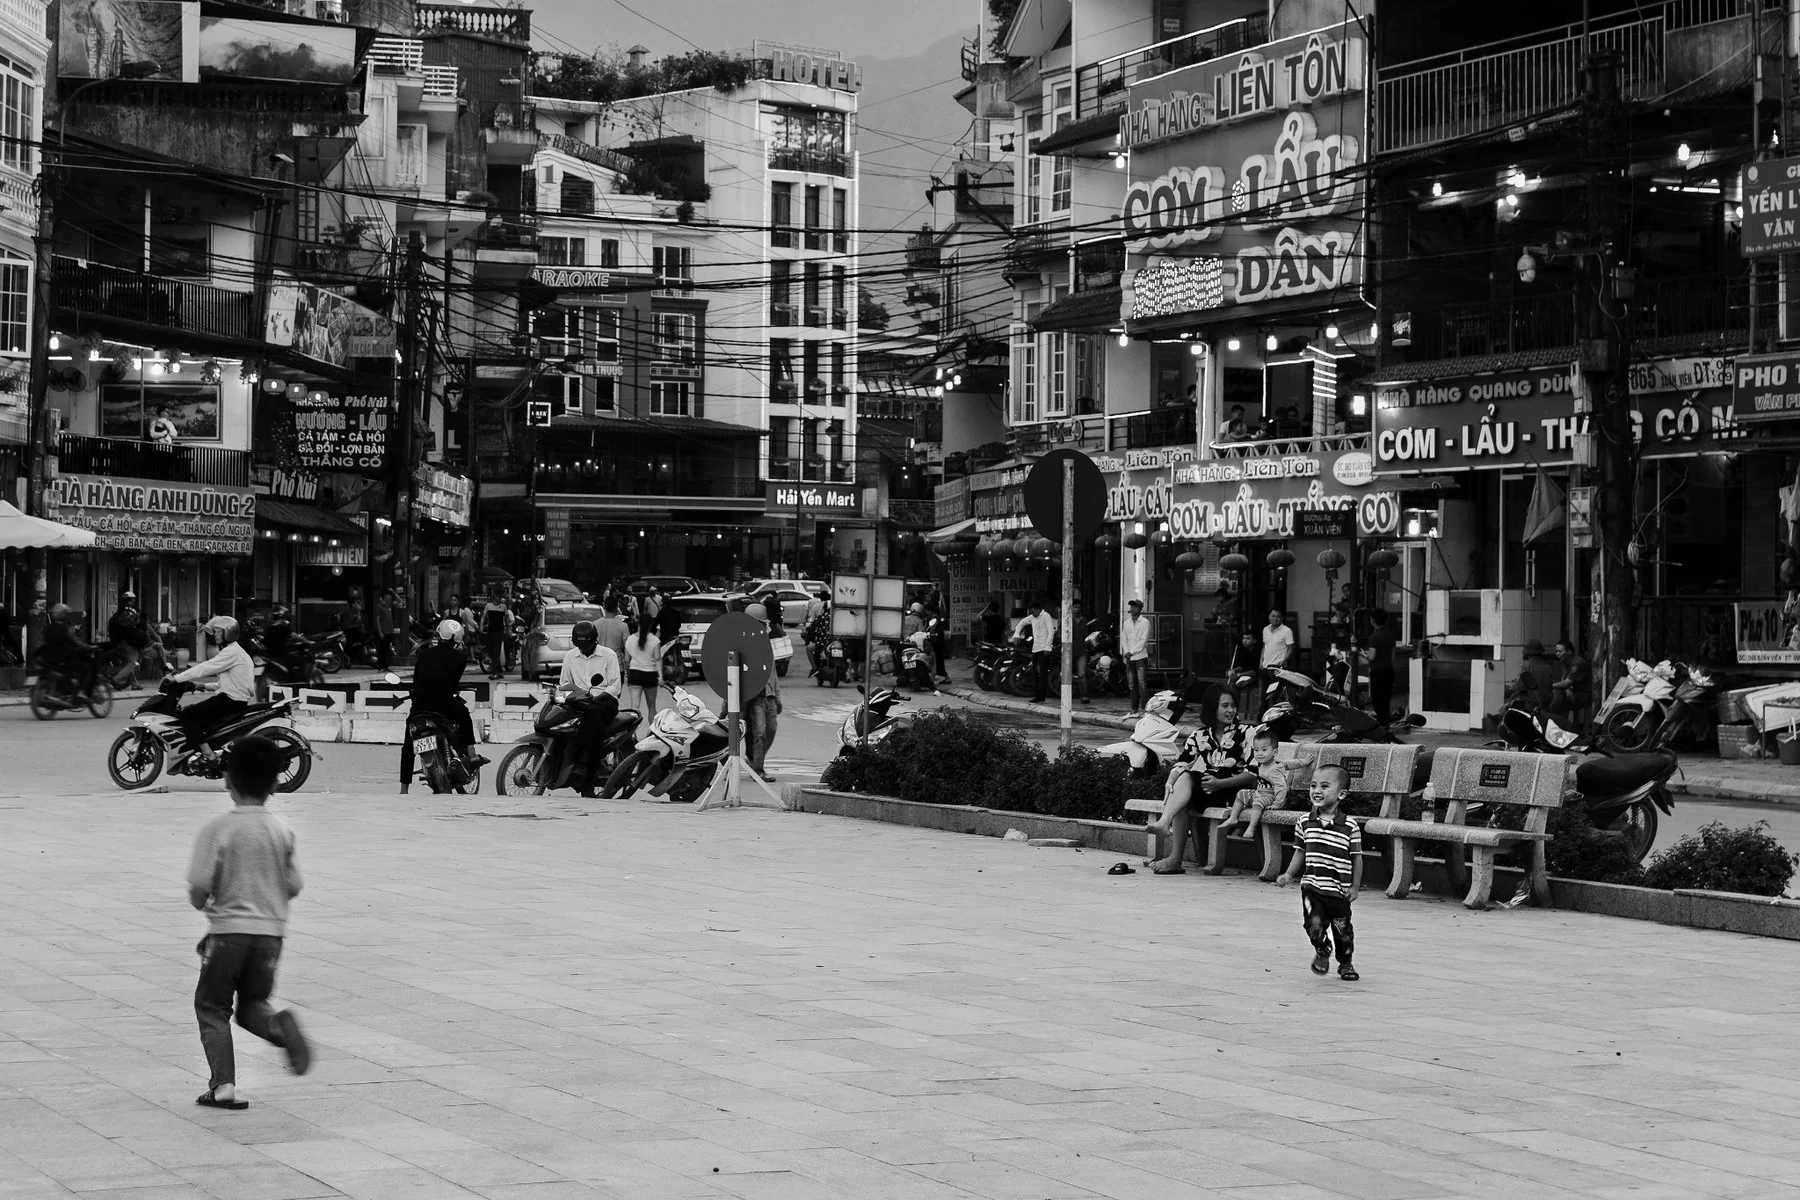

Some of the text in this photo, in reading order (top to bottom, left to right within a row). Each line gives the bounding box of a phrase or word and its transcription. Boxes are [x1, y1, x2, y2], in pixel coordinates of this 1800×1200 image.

[772, 48, 864, 92] HOTEL
[1214, 34, 1347, 121] LIÊN TÔN
[1119, 99, 1152, 148] NHÀ
[1122, 117, 1342, 242] CƠM LẨU
[1748, 185, 1783, 214] YẾN
[1763, 217, 1795, 238] VĂN
[530, 268, 610, 288] ARAOKE
[1238, 233, 1339, 298] DÂN
[1738, 365, 1788, 389] PHO
[344, 395, 366, 408] Phố
[367, 396, 388, 408] Núi
[1377, 374, 1572, 408] NHÀ HÀNG QUANG DŨN
[1754, 393, 1784, 411] VĂN
[295, 408, 387, 431] NƯỚNG LẨU
[1378, 426, 1436, 461] CƠM
[1461, 403, 1515, 456] LẨU
[1655, 390, 1700, 442] CỐ
[341, 444, 362, 454] LỢN
[363, 442, 385, 454] BẢN
[348, 431, 362, 442] CÁ
[366, 430, 385, 442] HỒI
[358, 454, 382, 468] CỐ
[1126, 451, 1159, 469] Liên
[1162, 448, 1192, 465] Tôn
[1175, 465, 1197, 484] NHÀ
[1242, 458, 1280, 478] Liên
[1281, 455, 1315, 477] Tôn
[53, 476, 83, 507] HÀ
[87, 479, 145, 510] HÀNG
[148, 487, 187, 514] ANH
[189, 487, 240, 517] DŨNG
[271, 469, 297, 498] Phố
[296, 472, 318, 500] Núi
[776, 488, 855, 507] Hải Yến Mart
[1111, 471, 1136, 518] LẨU
[1170, 501, 1212, 537] CƠM
[1222, 485, 1264, 535] LẨU
[100, 513, 114, 532] CÁ
[116, 512, 133, 533] HỒI
[139, 517, 152, 533] CÁ
[152, 516, 176, 536] TẦM
[227, 524, 251, 539] NGỰA
[1324, 522, 1342, 535] VIÊN
[114, 534, 126, 549] GÀ
[153, 536, 164, 550] GÀ
[166, 538, 183, 550] ĐEN
[189, 540, 205, 551] RAU
[228, 541, 239, 552] SA
[336, 544, 364, 564] VIÊN
[1740, 607, 1778, 642] Phở 10
